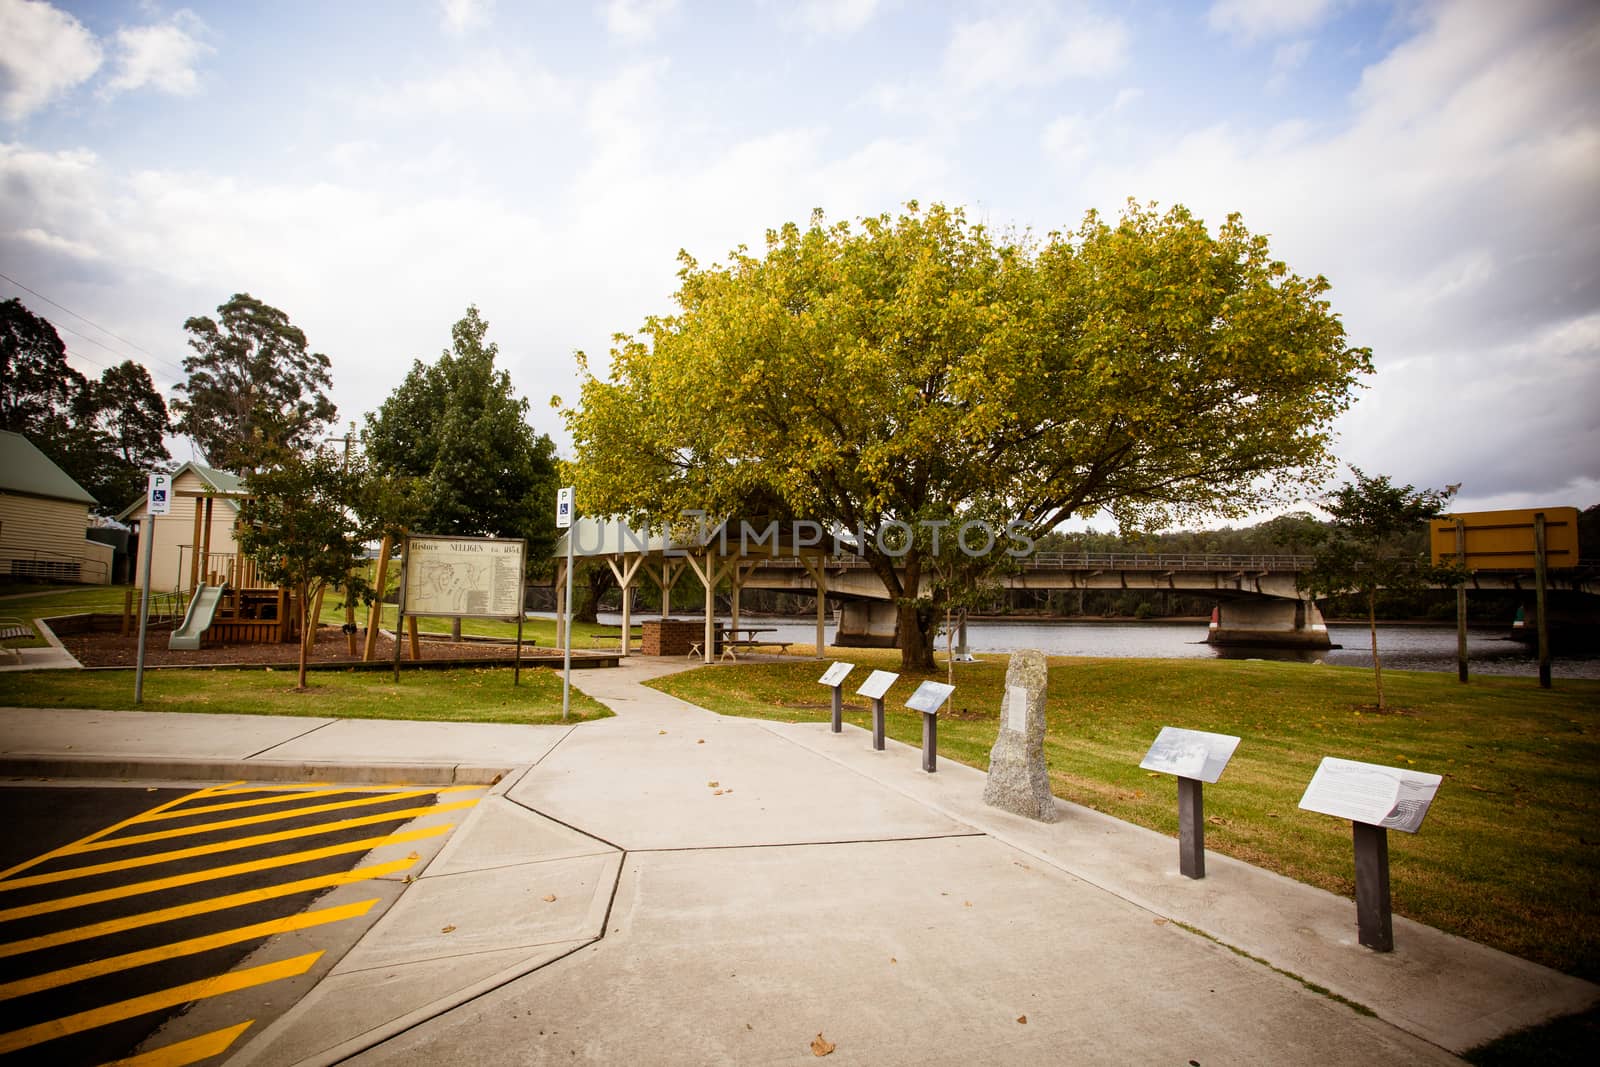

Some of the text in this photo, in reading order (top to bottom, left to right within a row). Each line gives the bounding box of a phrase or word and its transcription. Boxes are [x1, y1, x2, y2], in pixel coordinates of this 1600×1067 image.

[156, 477, 164, 486] P
[562, 491, 568, 500] P
[450, 544, 484, 552] NELLIGEN
